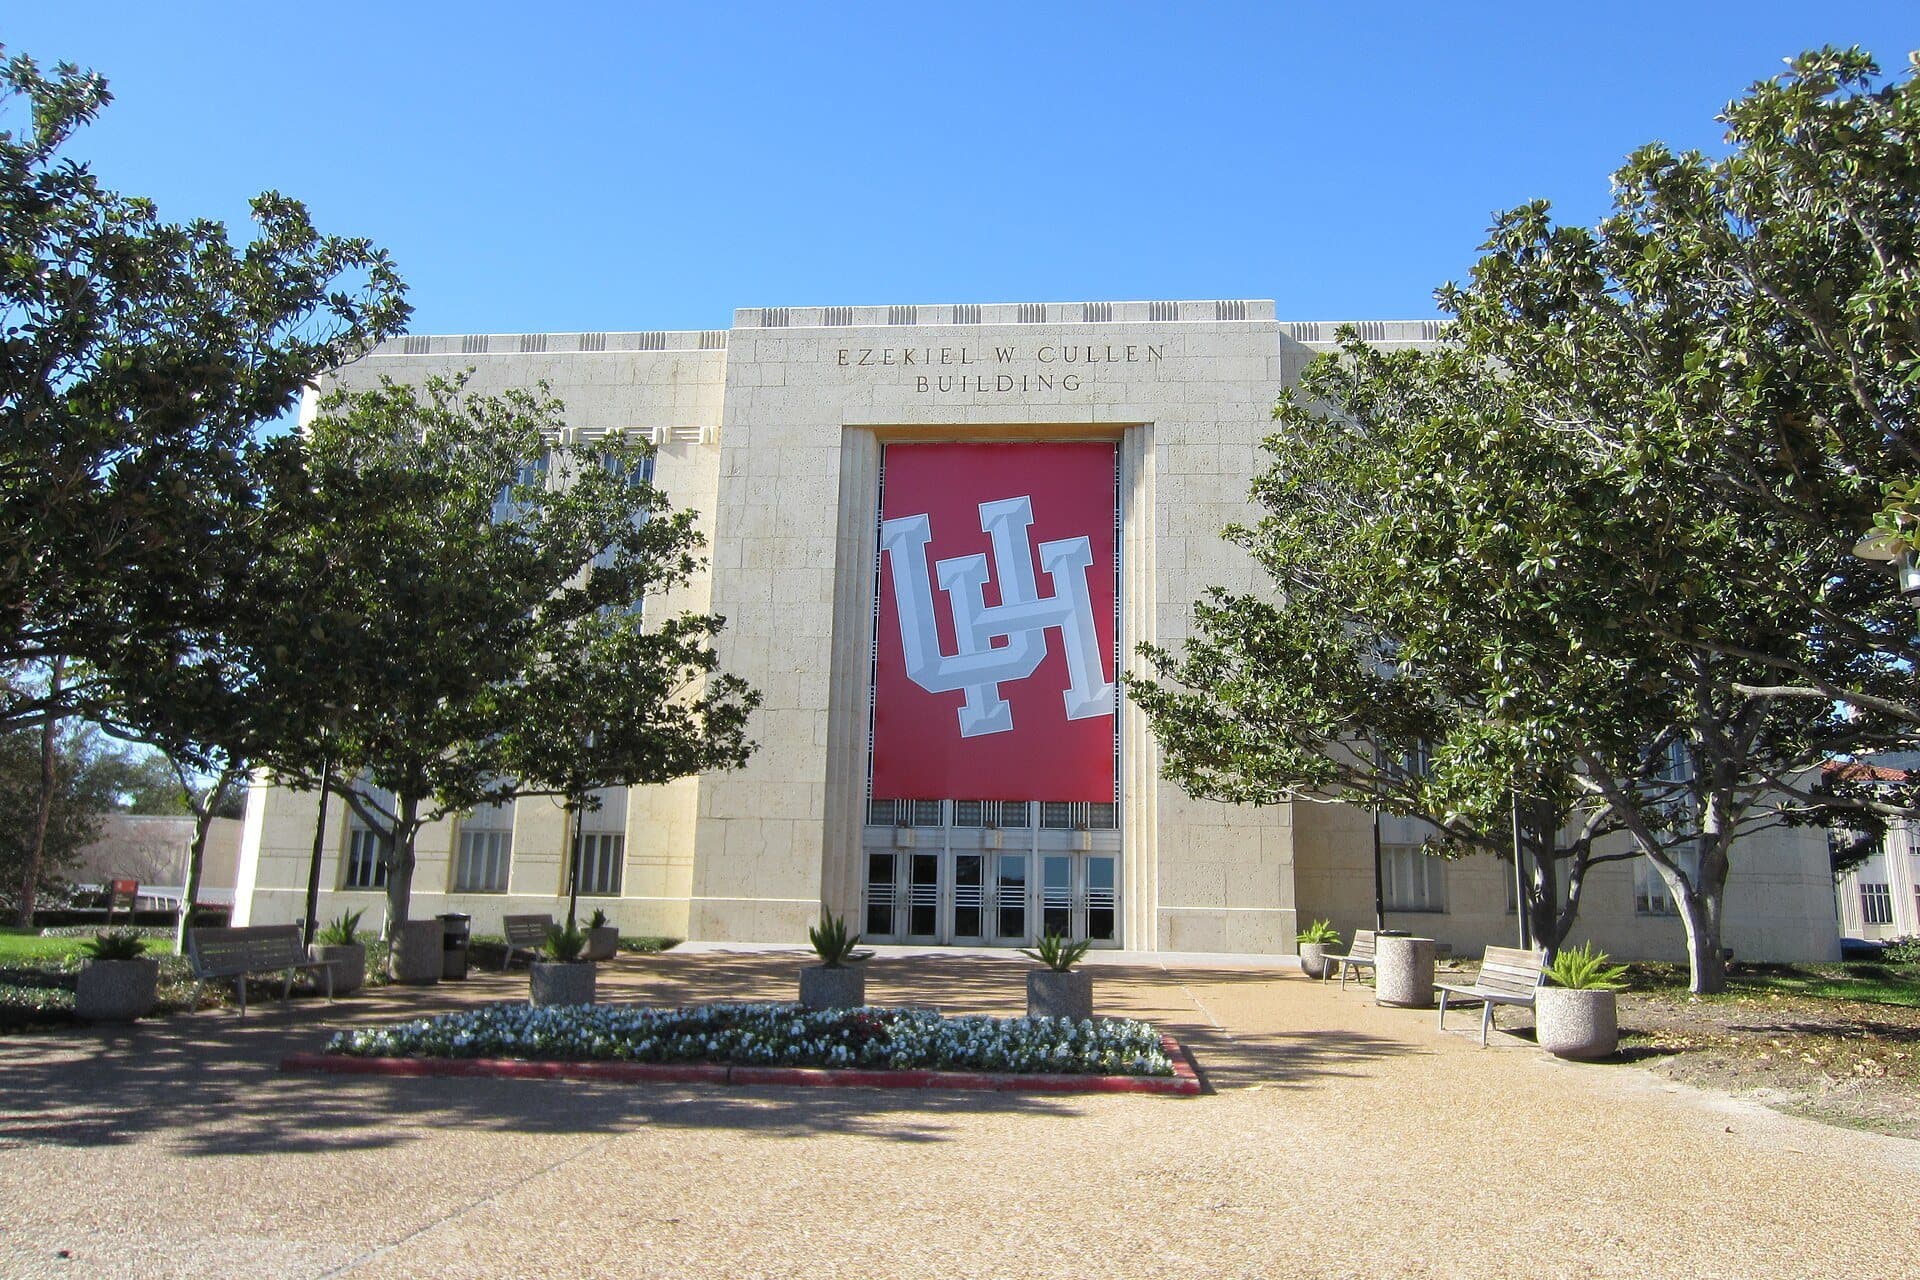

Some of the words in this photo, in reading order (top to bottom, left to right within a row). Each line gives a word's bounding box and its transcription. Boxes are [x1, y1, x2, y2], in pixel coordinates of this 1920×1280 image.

[838, 348, 974, 366] EZEKIEL
[995, 346, 1016, 364] W
[1037, 344, 1165, 364] CULLEN
[916, 374, 1081, 393] BUILDING
[881, 495, 1114, 738] UH
